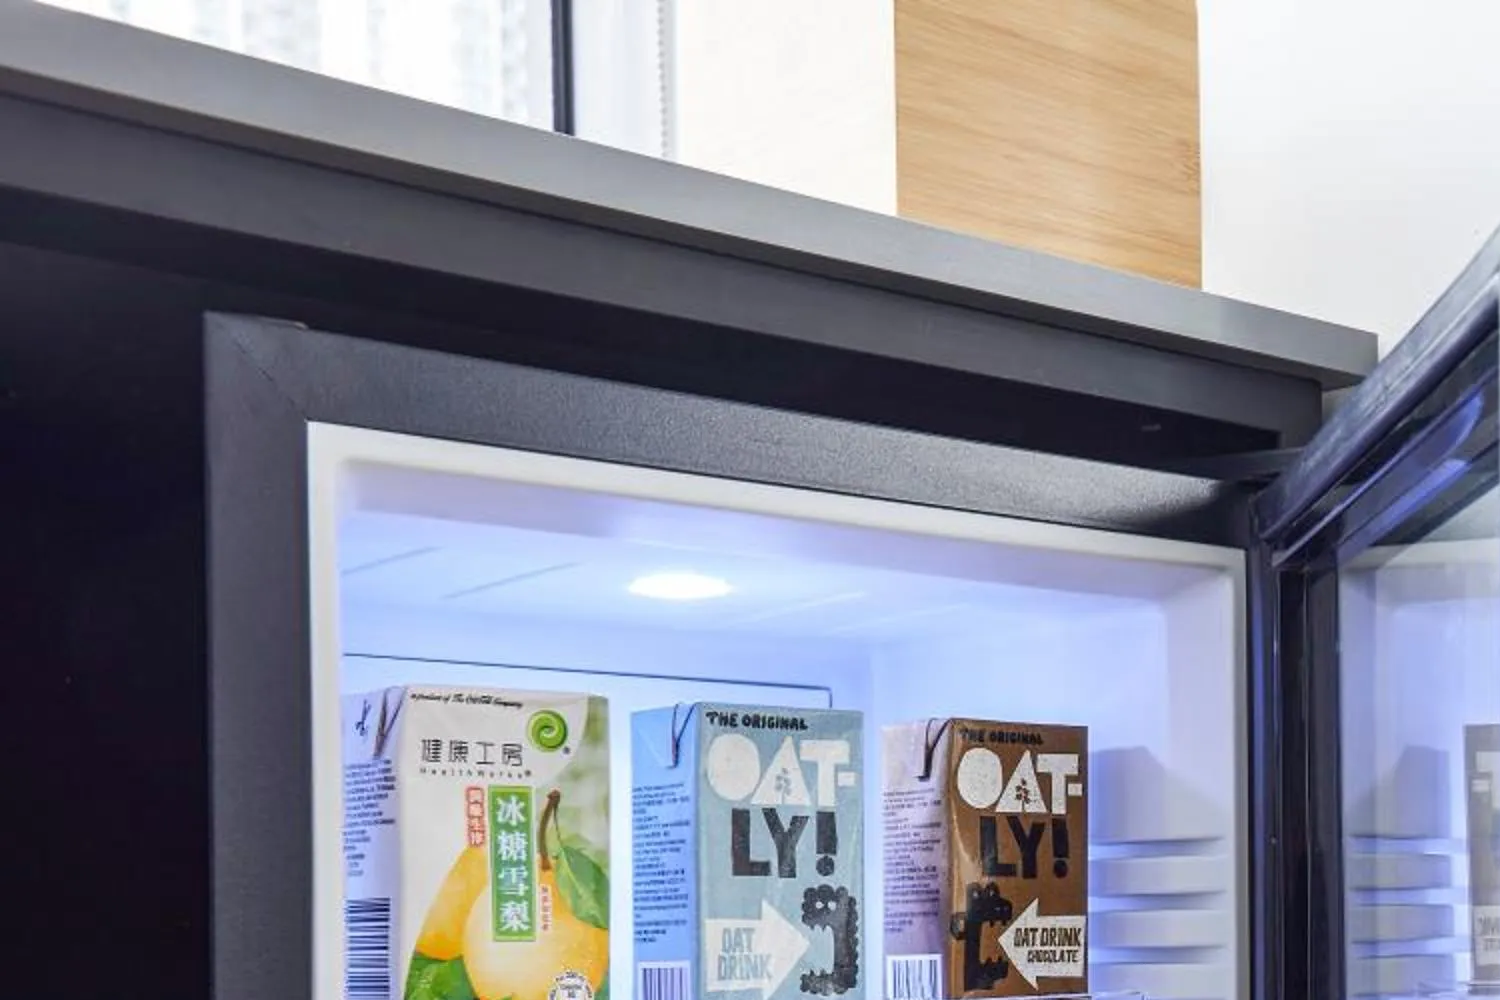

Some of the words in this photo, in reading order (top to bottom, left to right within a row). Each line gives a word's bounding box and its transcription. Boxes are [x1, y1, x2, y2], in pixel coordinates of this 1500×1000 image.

[706, 711, 738, 728] THE
[741, 714, 808, 730] ORIGINAL
[959, 728, 985, 743] THE
[989, 731, 1044, 745] ORIGINAL
[420, 738, 523, 767] 健康工房
[707, 733, 856, 807] OAT-
[957, 747, 1083, 815] OAT-
[731, 807, 838, 879] LY!
[980, 815, 1070, 879] LY!
[495, 794, 531, 932] 冰糖雪梨
[721, 927, 756, 953] OAT
[1013, 927, 1039, 947] OAT
[1040, 927, 1082, 947] DRINK
[717, 952, 774, 982] DRINK
